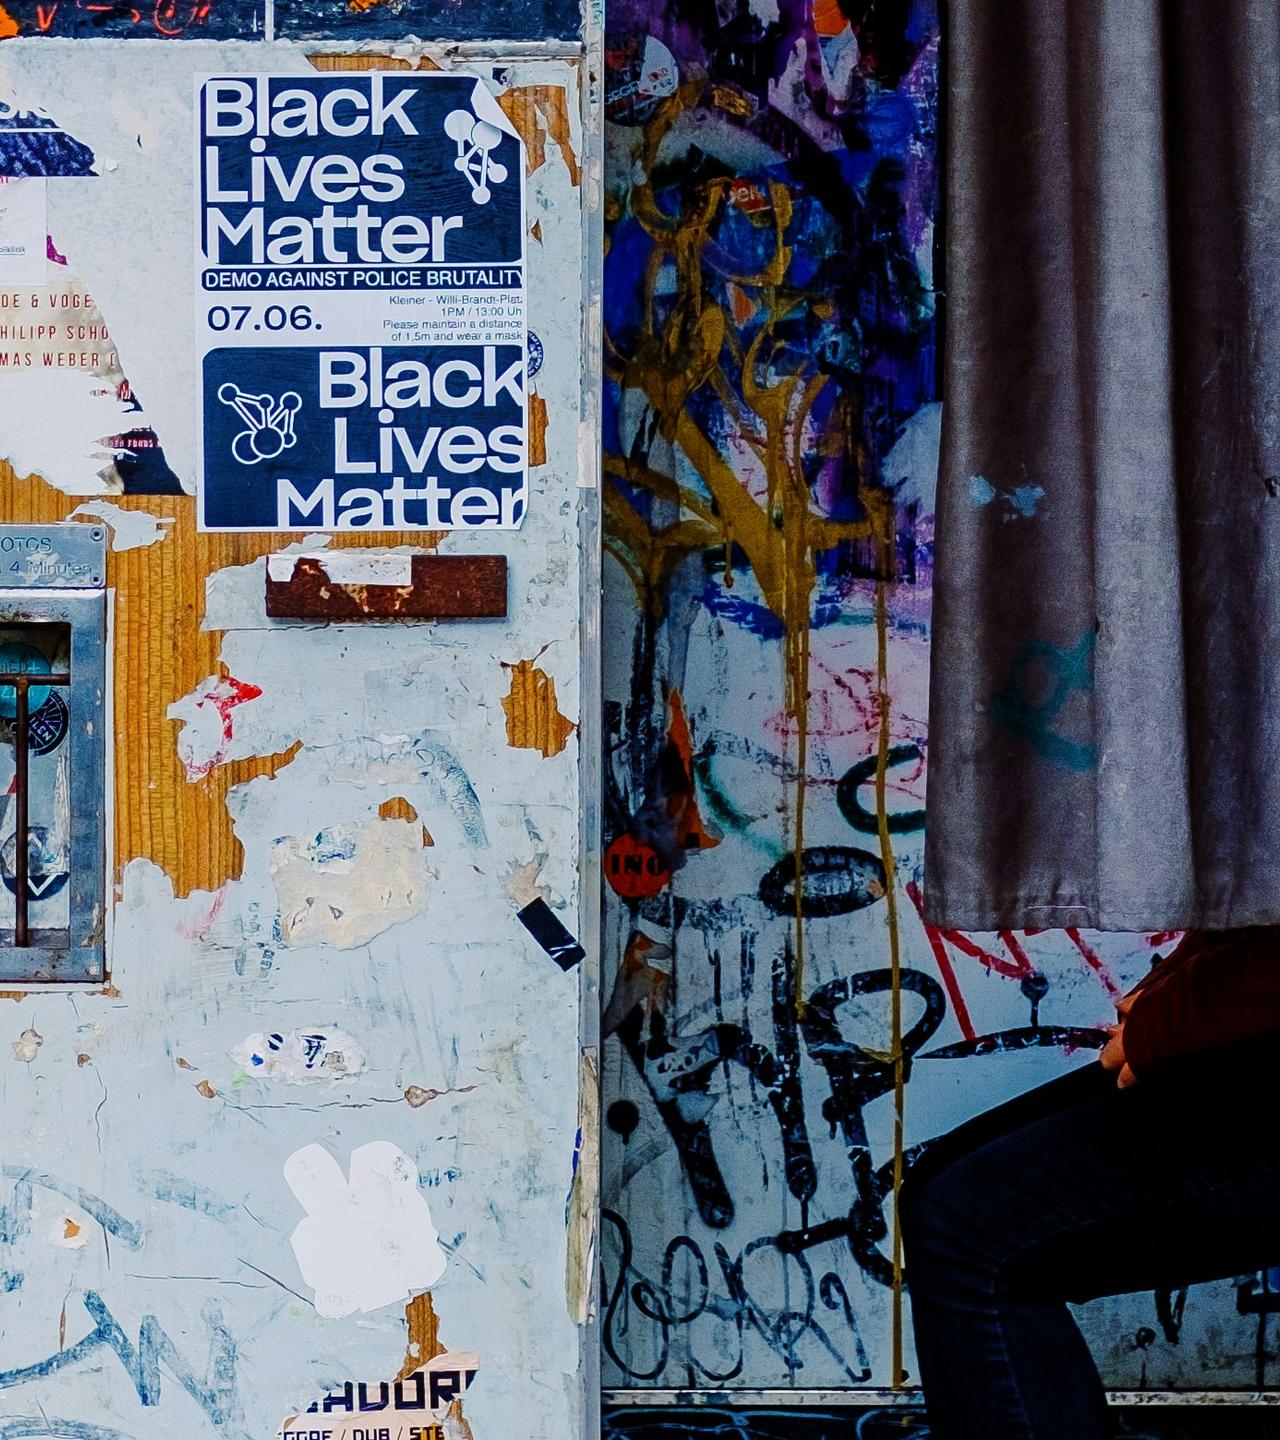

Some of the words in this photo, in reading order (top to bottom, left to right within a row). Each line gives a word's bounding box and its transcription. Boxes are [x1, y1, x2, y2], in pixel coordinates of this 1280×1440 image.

[205, 79, 418, 137] Black
[206, 138, 405, 203] Lives
[206, 205, 464, 263] Matter
[205, 271, 262, 288] DEMO
[266, 271, 348, 287] AGAINST
[354, 270, 422, 287] POLICE
[426, 270, 522, 286] BRUTALITY
[31, 295, 38, 308] &
[389, 295, 427, 306] Kleiner
[207, 305, 322, 331] 07.06.
[475, 306, 504, 316] 13:00
[383, 319, 419, 329] Please
[421, 319, 467, 328] maintain
[479, 319, 522, 328] distance
[433, 331, 453, 341] and
[42, 352, 97, 367] WEBER
[319, 350, 525, 409] Black
[334, 409, 527, 475] Lives
[276, 479, 525, 529] Matter
[9, 560, 21, 574] 4
